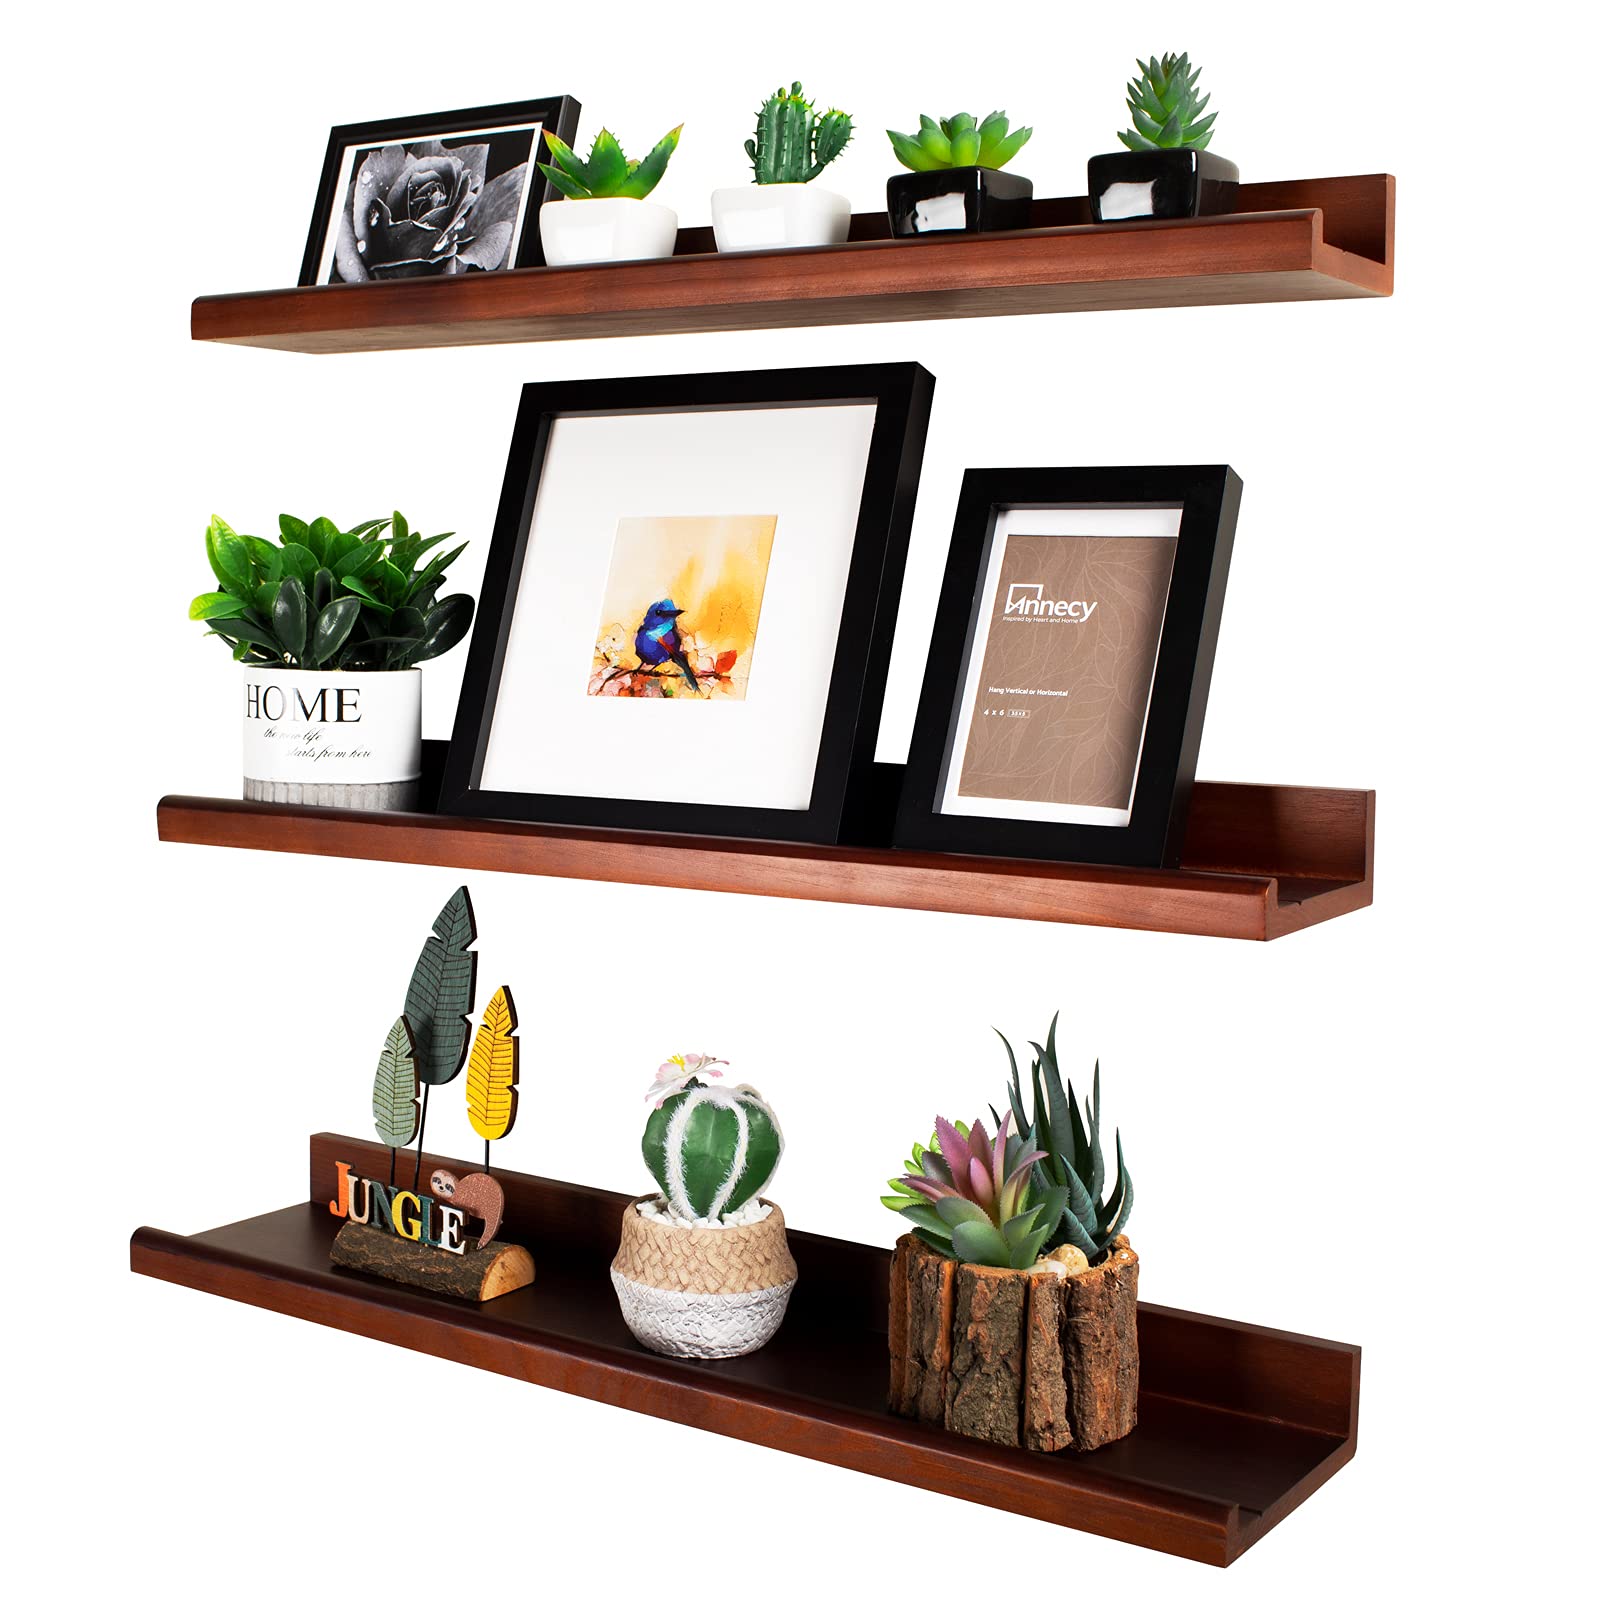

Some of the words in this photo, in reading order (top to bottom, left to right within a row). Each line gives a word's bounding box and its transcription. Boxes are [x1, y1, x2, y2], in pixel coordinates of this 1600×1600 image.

[1004, 584, 1098, 622] Annecy
[988, 686, 1004, 694] Hang
[1005, 687, 1029, 695] Vertical
[1036, 689, 1069, 697] Horizontal
[246, 683, 362, 722] HOME
[983, 708, 989, 716] 4
[264, 726, 277, 738] the
[303, 728, 325, 745] life
[314, 744, 346, 762] from
[348, 745, 371, 758] here
[329, 1160, 466, 1256] JUNGLE
